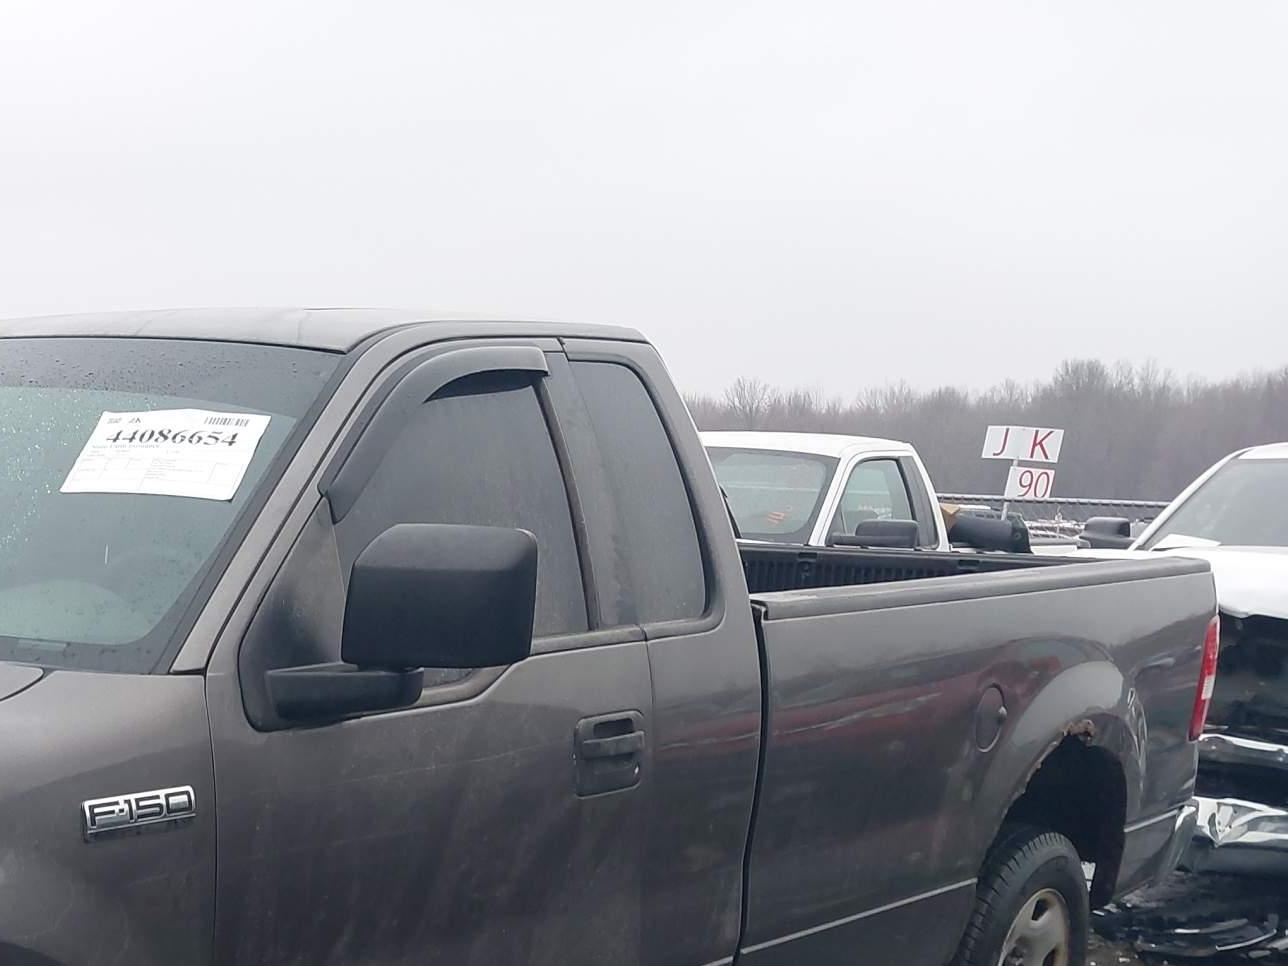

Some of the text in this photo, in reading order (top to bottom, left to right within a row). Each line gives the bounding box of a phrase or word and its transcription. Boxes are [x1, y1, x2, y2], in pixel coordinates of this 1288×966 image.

[106, 428, 239, 447] 44086654
[992, 427, 1055, 460] J K
[1017, 469, 1050, 498] 90
[87, 789, 194, 830] F-150
